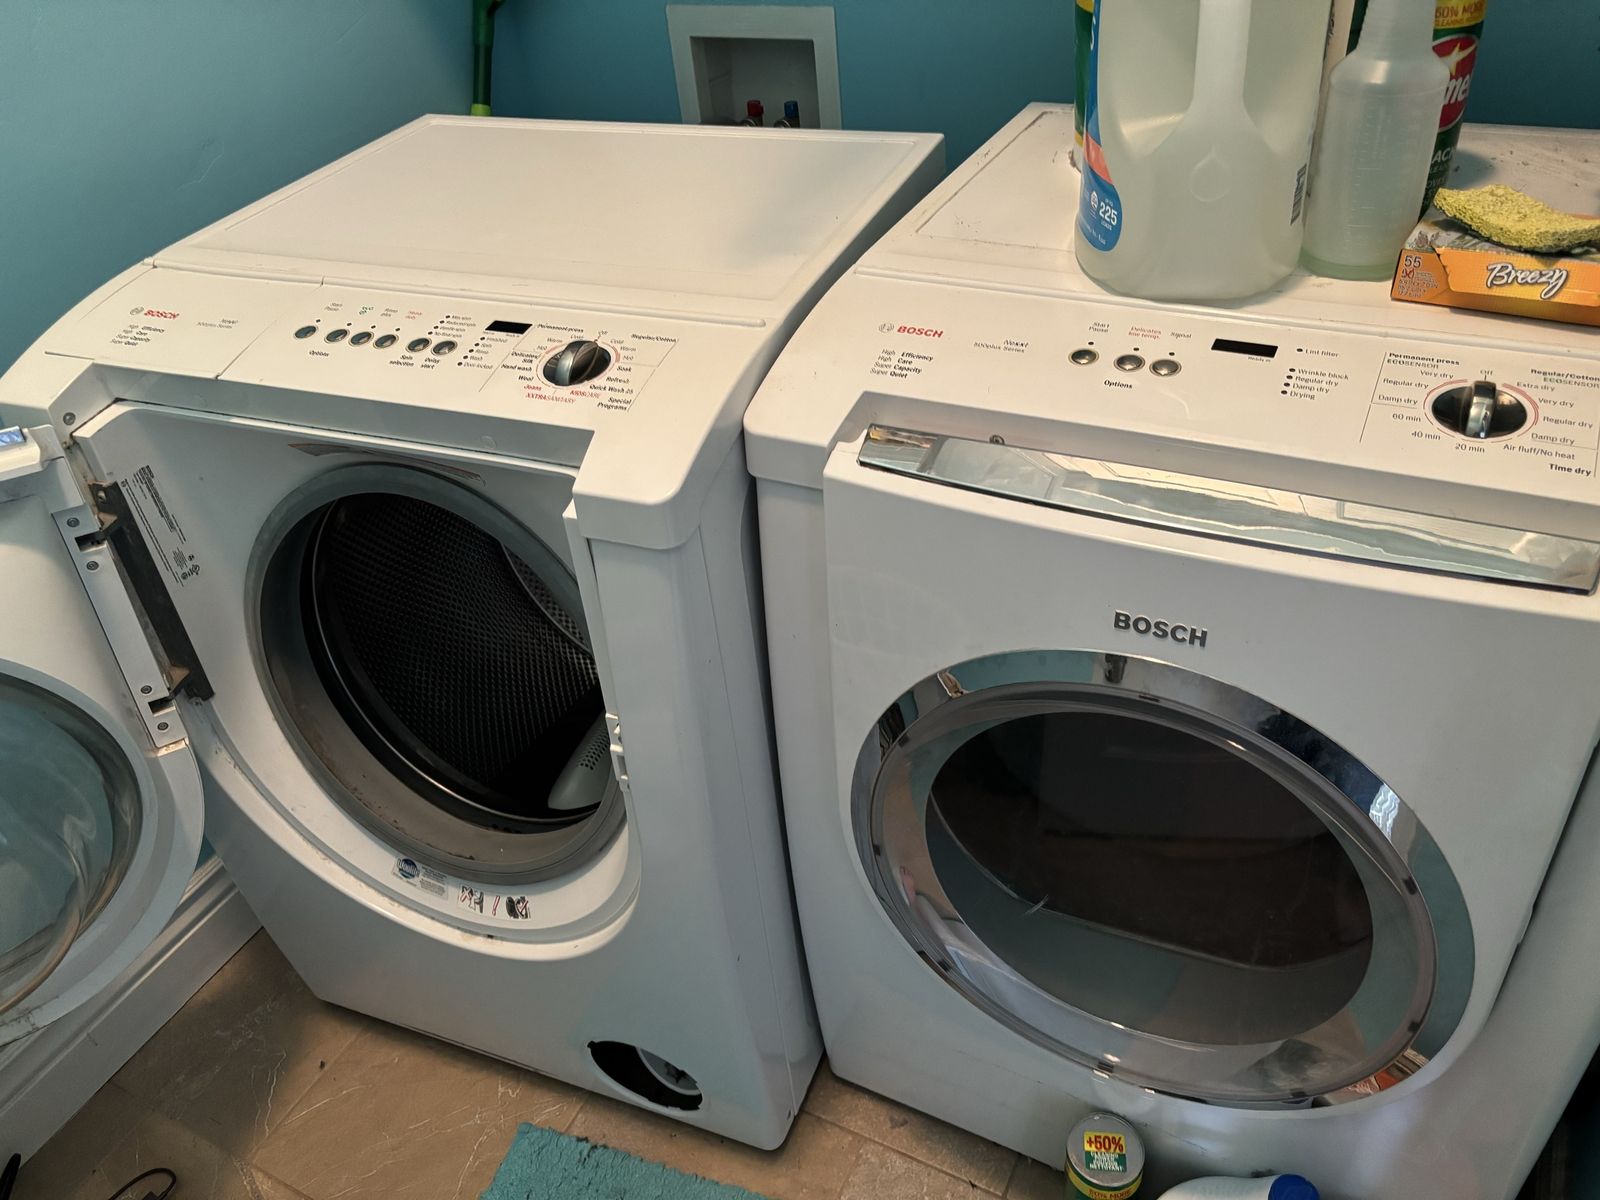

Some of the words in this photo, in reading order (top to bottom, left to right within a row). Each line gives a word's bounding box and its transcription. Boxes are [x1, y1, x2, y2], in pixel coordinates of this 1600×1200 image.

[1099, 202, 1118, 226] 225
[1404, 255, 1422, 268] 55
[1486, 262, 1568, 299] Breezy
[144, 309, 179, 319] BOSCH
[897, 325, 944, 339] BOSCH
[881, 348, 896, 357] High
[901, 351, 933, 362] Efficiency
[1305, 348, 1320, 356] Lint
[1321, 349, 1339, 358] filter
[1389, 352, 1435, 363] Permanent
[1436, 358, 1460, 366] press
[878, 355, 892, 363] High
[897, 357, 913, 365] Care
[1386, 358, 1439, 370] ECOSENSOR
[870, 367, 888, 376] Super
[889, 370, 907, 379] Quiet
[874, 361, 892, 370] Super
[893, 364, 922, 375] Capacity
[1298, 368, 1327, 377] Wrinkle
[1328, 371, 1349, 380] block
[1295, 375, 1324, 385] Regular
[1325, 378, 1339, 387] dry
[1420, 370, 1438, 378] Very
[1439, 371, 1454, 380] dry
[1531, 368, 1600, 382] Regular/Cotton
[1104, 379, 1133, 389] Options
[1292, 382, 1316, 392] Damp
[1316, 386, 1330, 394] dry
[1383, 377, 1413, 387] Regular
[1414, 382, 1429, 390] dry
[1516, 382, 1539, 390] Extra
[608, 396, 632, 405] Special
[1289, 390, 1316, 400] Drying
[1378, 394, 1403, 404] Damp
[1403, 397, 1418, 406] dry
[597, 402, 627, 411] Programs
[1538, 398, 1558, 407] Very
[1559, 400, 1575, 409] dry
[1392, 413, 1404, 421] 60
[1405, 414, 1421, 422] min
[1543, 416, 1576, 426] Regular
[1577, 420, 1594, 429] dry
[1411, 431, 1424, 439] 40
[1424, 432, 1441, 440] min
[1531, 433, 1558, 443] Damp
[1559, 437, 1575, 446] dry
[1455, 442, 1467, 451] 20
[1468, 445, 1485, 453] min
[1518, 445, 1553, 457] fluff/No
[1554, 451, 1575, 460] heat
[1549, 463, 1573, 473] Time
[1574, 467, 1592, 477] dry
[1113, 609, 1208, 648] BOSCH
[1086, 1134, 1124, 1153] +50%
